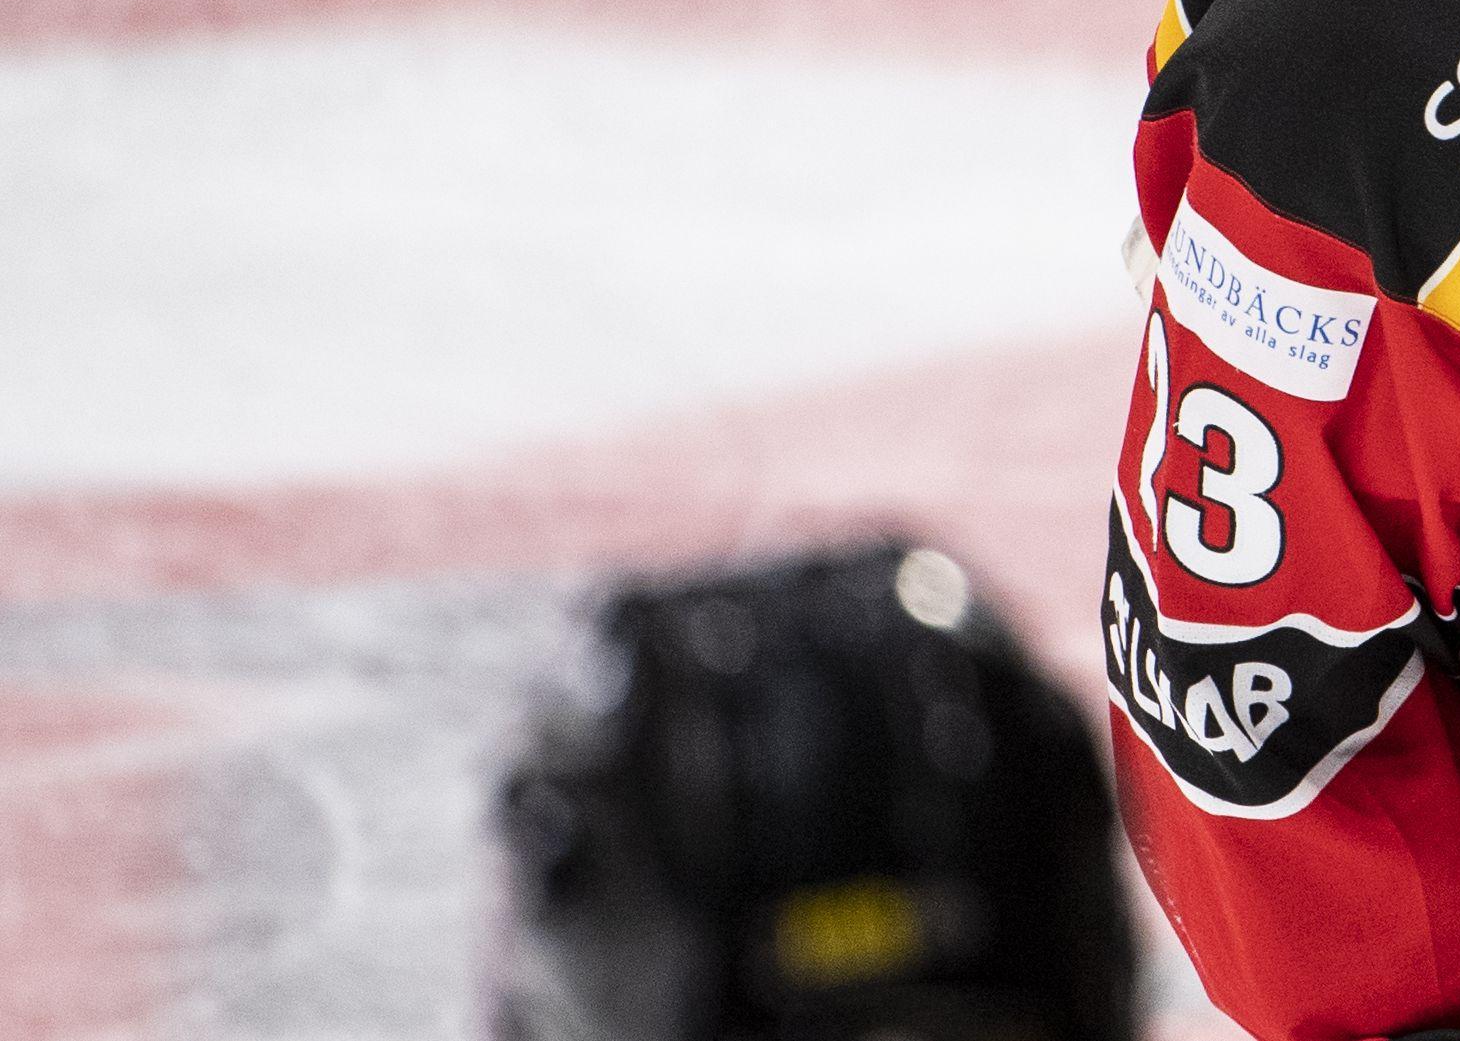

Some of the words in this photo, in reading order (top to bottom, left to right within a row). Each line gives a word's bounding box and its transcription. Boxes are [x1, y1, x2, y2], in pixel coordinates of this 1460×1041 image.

[1169, 219, 1362, 347] UNDBÄCKS
[1221, 310, 1237, 327] av
[1245, 325, 1277, 349] alla
[1289, 344, 1331, 370] slag
[1130, 616, 1293, 763] LKAB
